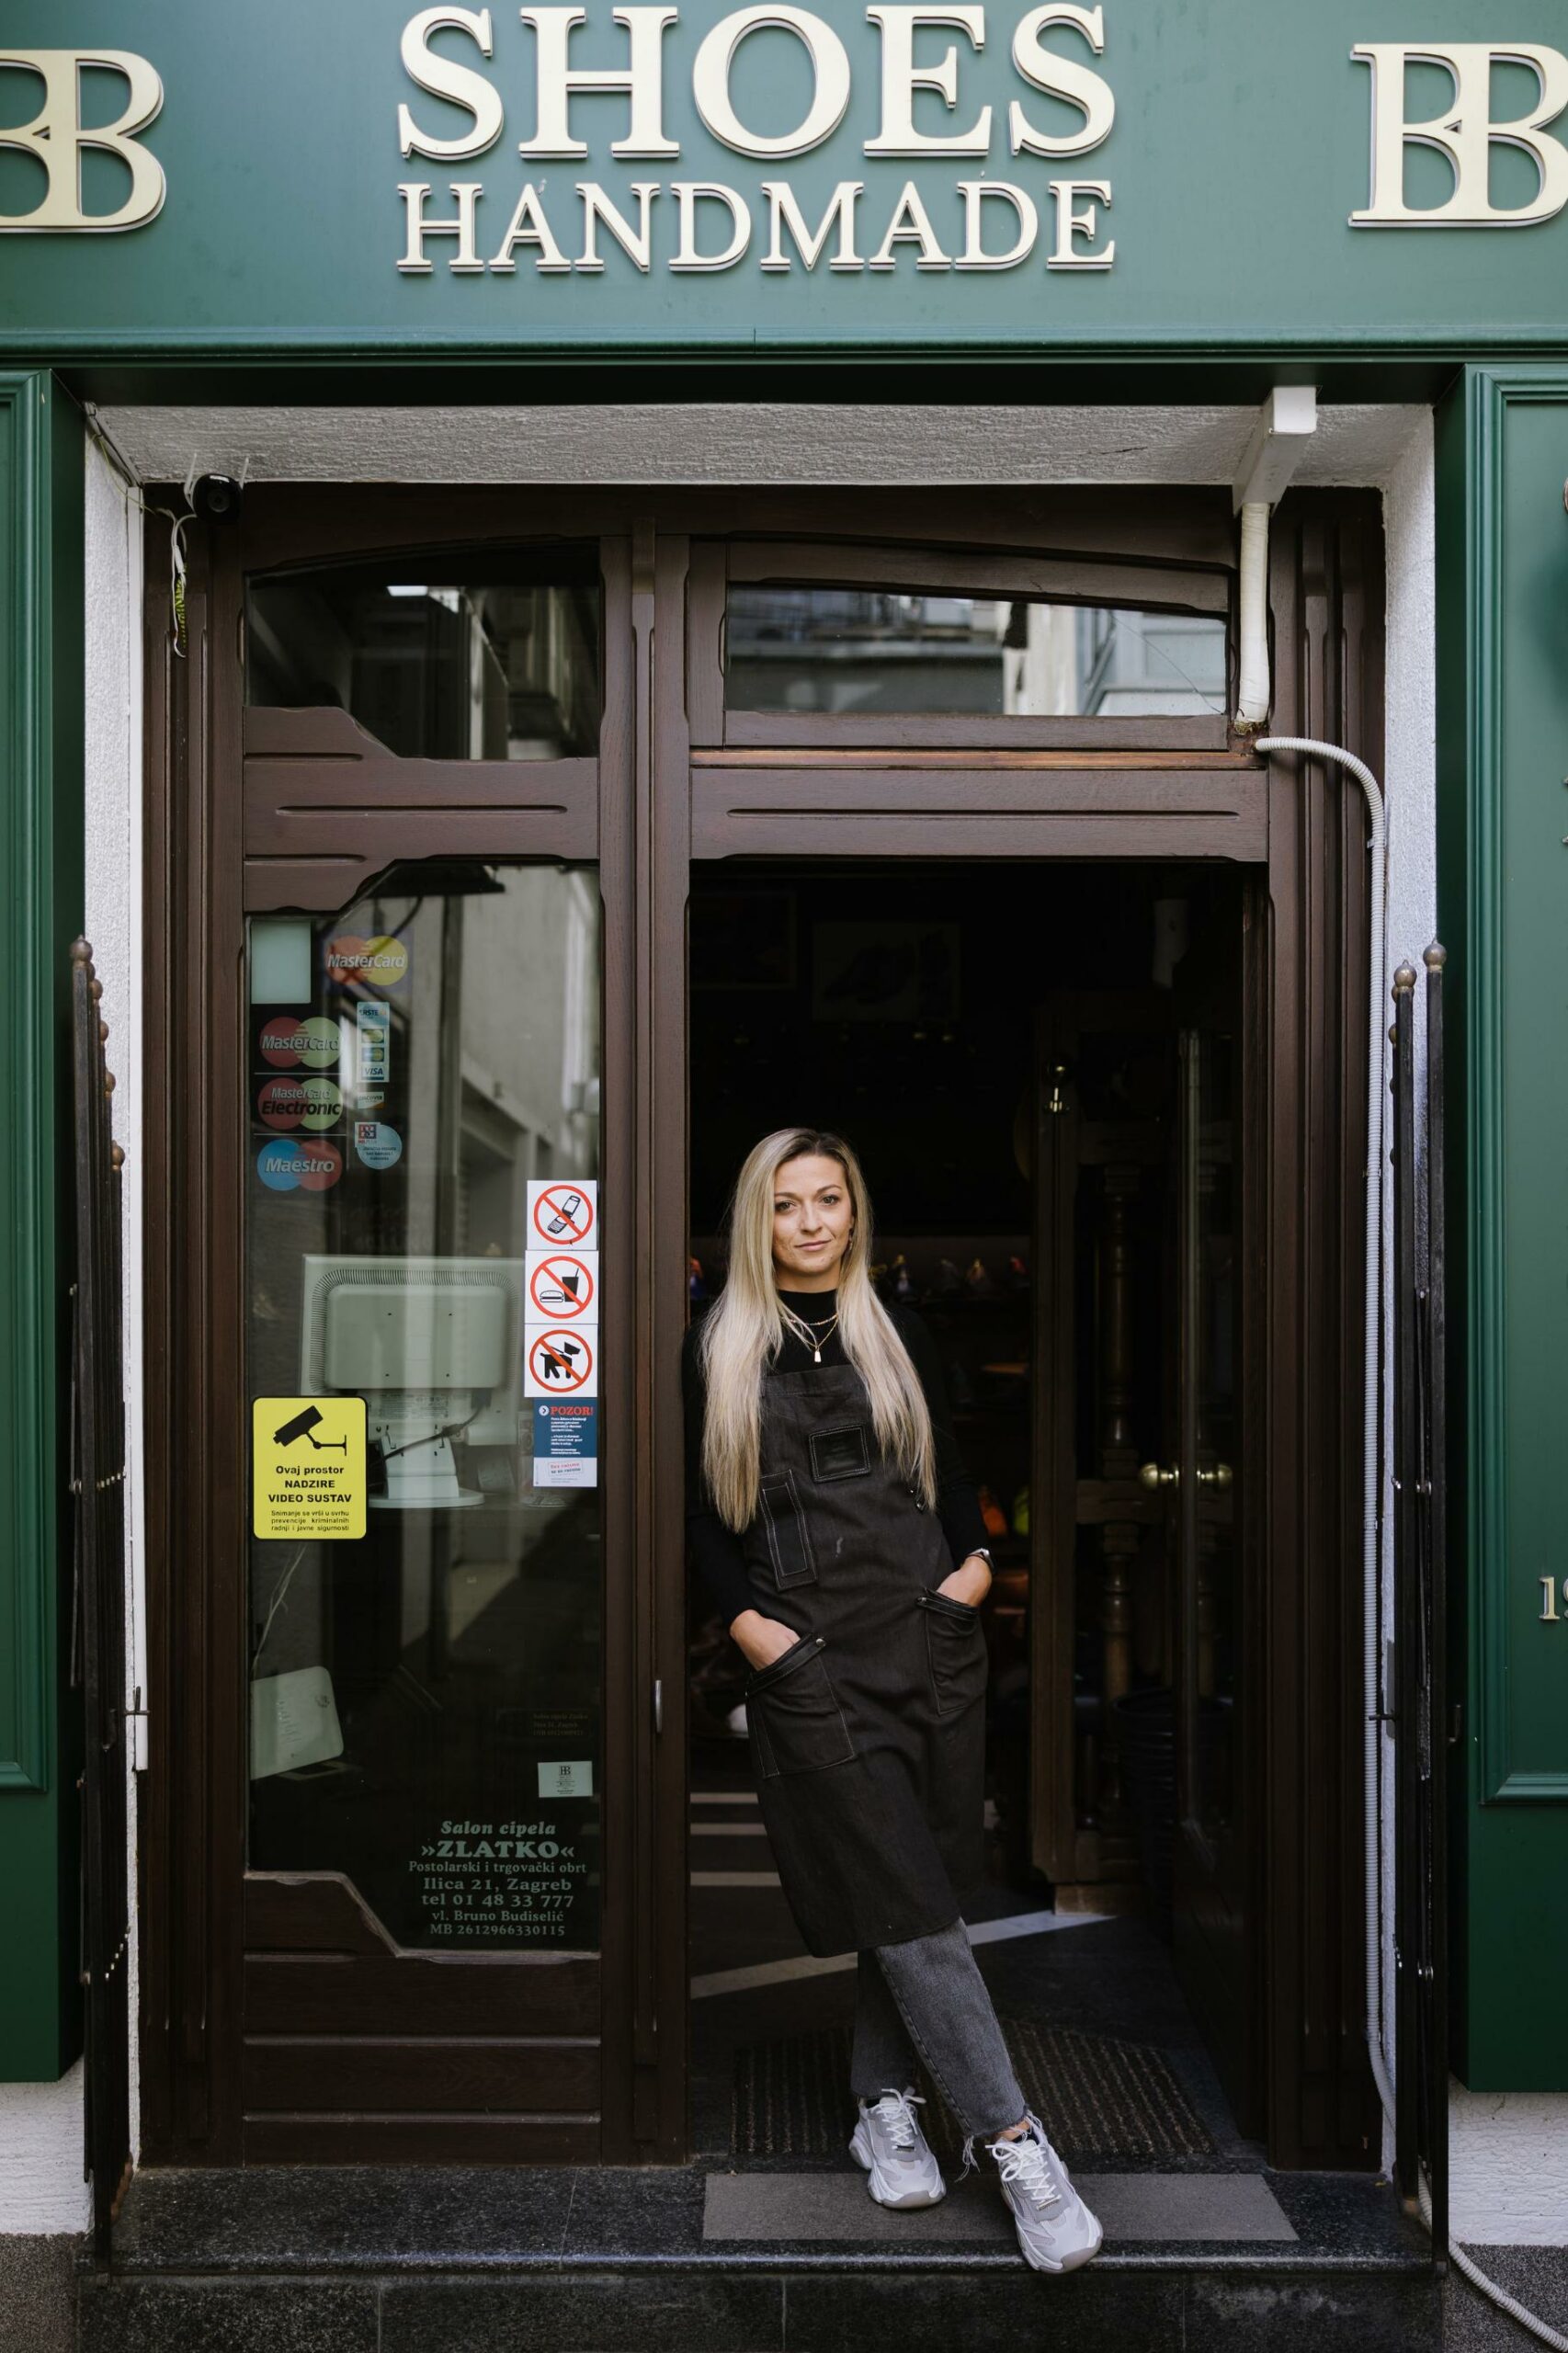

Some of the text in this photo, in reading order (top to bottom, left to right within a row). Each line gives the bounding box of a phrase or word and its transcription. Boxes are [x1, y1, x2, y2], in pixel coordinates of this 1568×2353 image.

[397, 4, 1116, 161] SHOES
[396, 180, 1116, 273] HANDMADE
[328, 954, 405, 969] MasterCard
[262, 1035, 340, 1051] MasterCard
[365, 1067, 383, 1075] VISA
[262, 1100, 341, 1116] Electronic
[265, 1157, 335, 1173] Maestro
[550, 1406, 594, 1416] POZOR!
[276, 1465, 345, 1475] Ovaj prostor
[284, 1480, 335, 1488] NADZIRE
[267, 1494, 352, 1503] VIDEO SUSTAV
[1539, 1575, 1568, 1620] 1
[440, 1820, 556, 1837] Salon cipela
[408, 1860, 587, 1875] Postolarski i trgovački obrt
[423, 1877, 572, 1893] Ilica 21, Zagreb
[421, 1893, 574, 1908] tel 01 48 33 777
[432, 1910, 564, 1922] vl. Bruno Budiselić
[430, 1924, 453, 1935] MB
